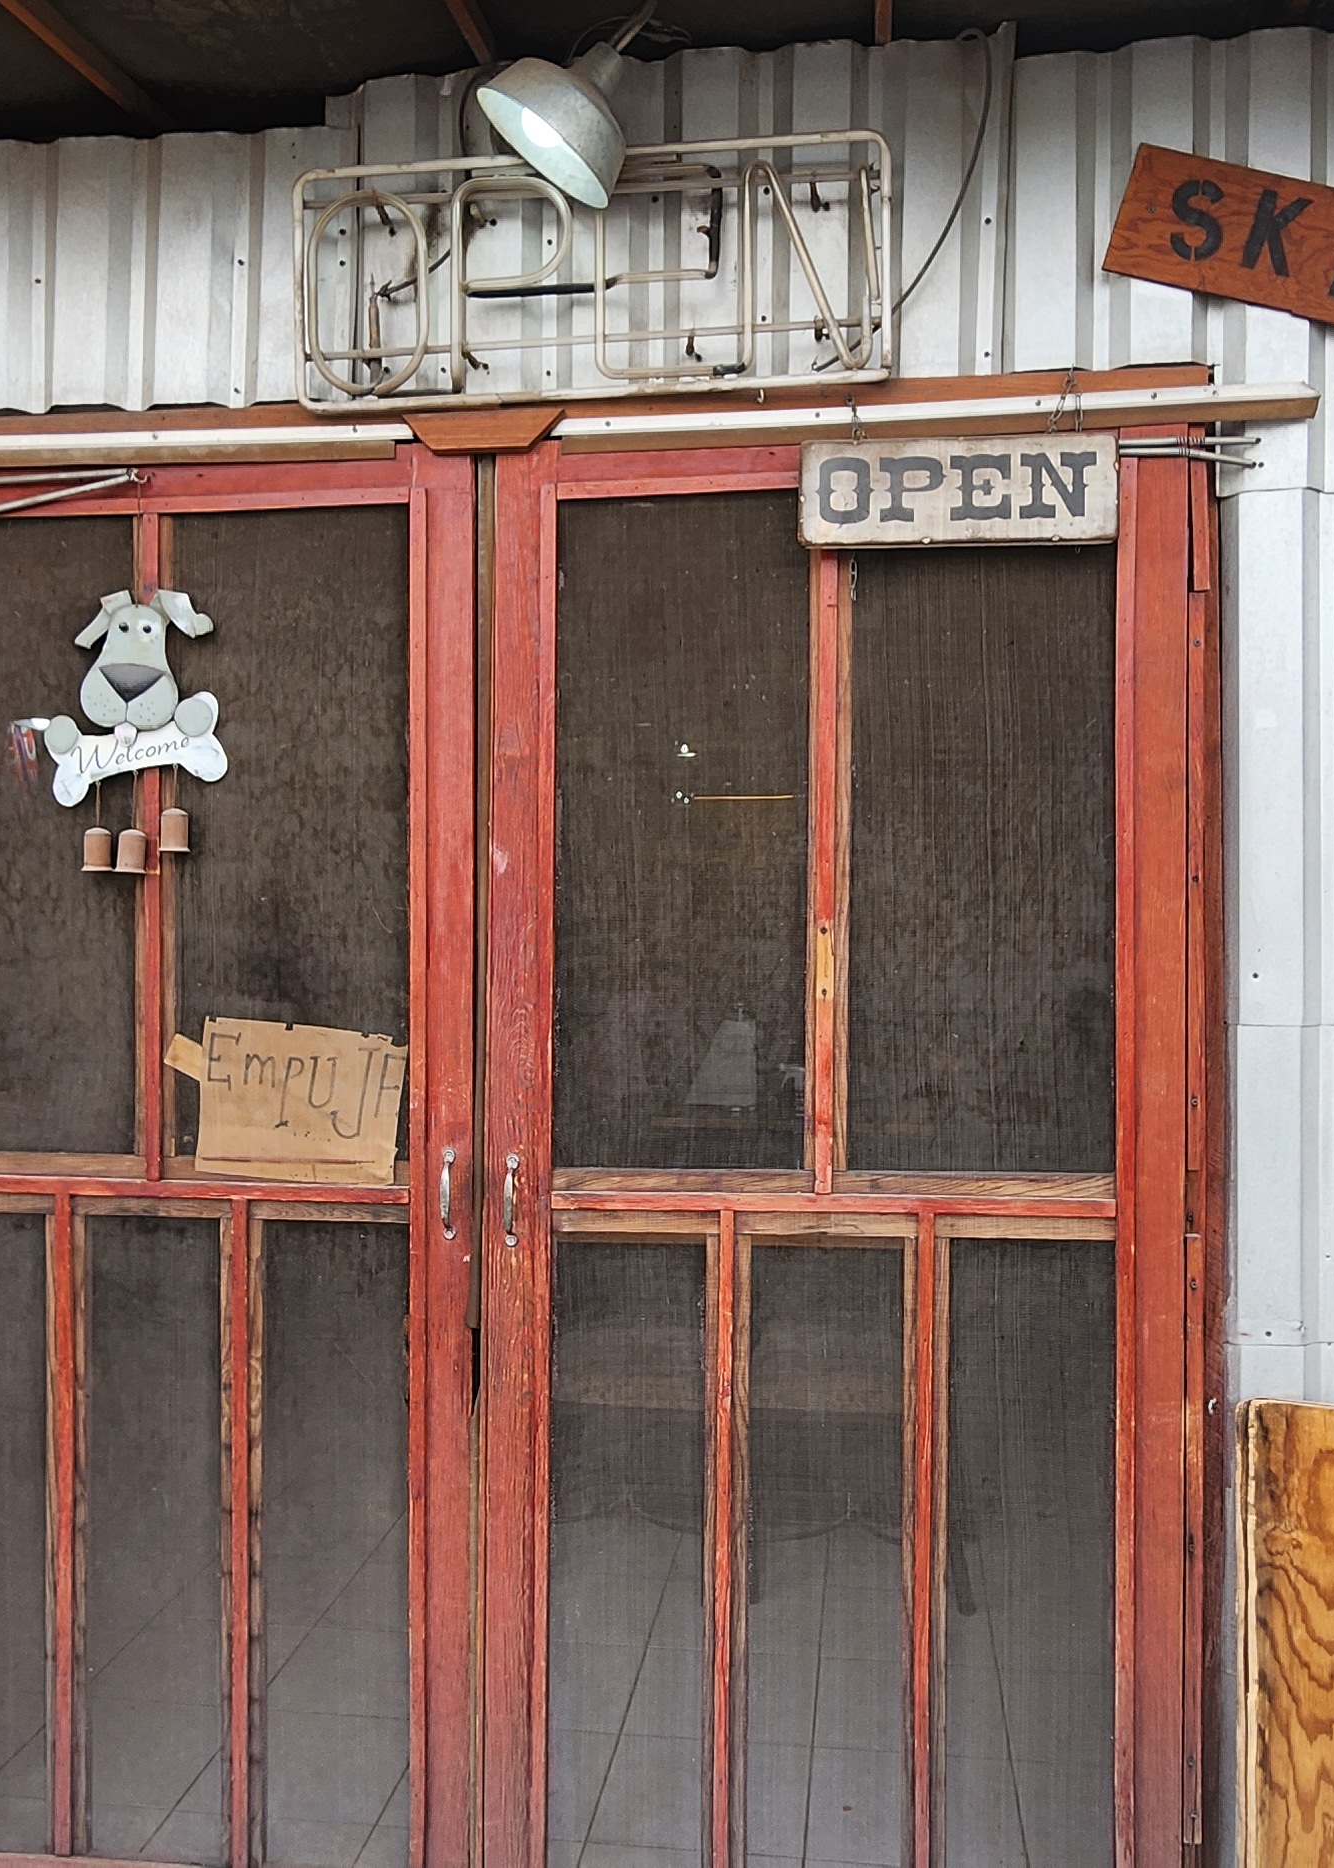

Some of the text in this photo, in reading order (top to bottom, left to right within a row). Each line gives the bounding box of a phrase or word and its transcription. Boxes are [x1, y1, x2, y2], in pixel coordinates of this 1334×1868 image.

[307, 160, 879, 396] OPEN
[814, 450, 1098, 524] OPEN
[70, 736, 190, 774] Welcome
